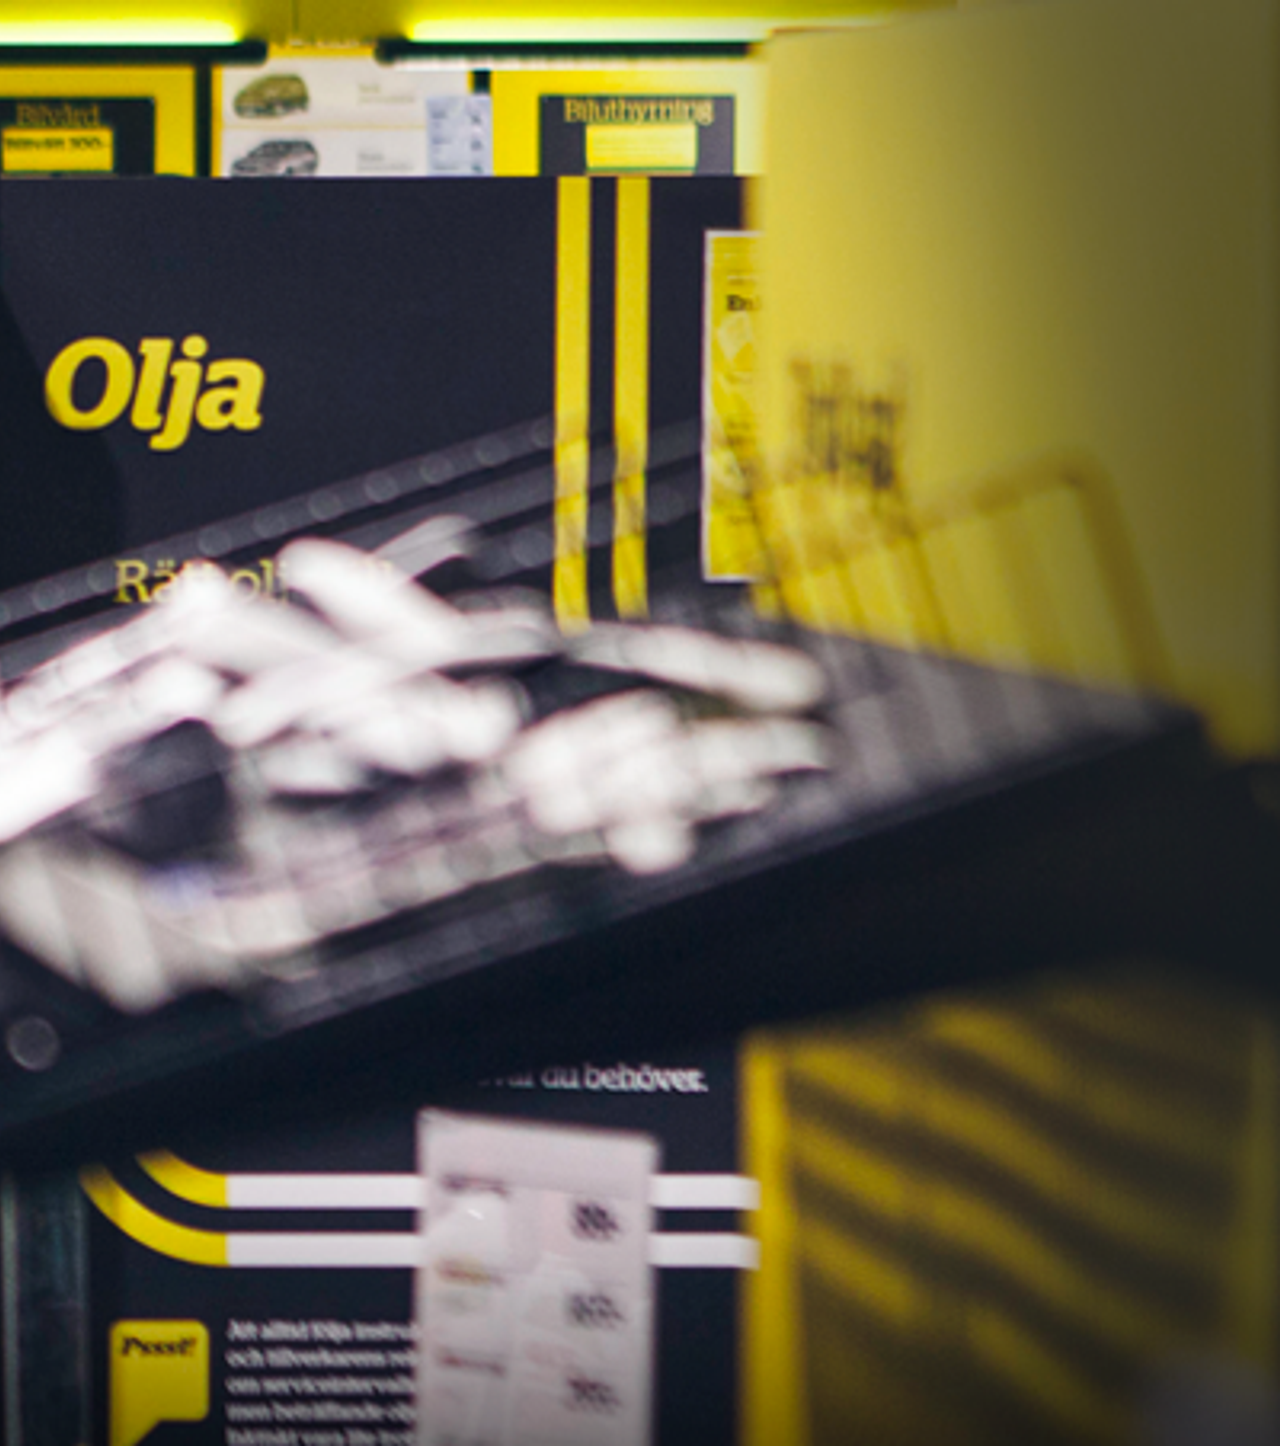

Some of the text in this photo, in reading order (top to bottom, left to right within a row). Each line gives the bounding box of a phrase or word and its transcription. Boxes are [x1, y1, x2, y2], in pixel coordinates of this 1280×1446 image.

[564, 98, 714, 126] Biluthyrning
[45, 334, 266, 450] Olja
[584, 1062, 709, 1092] behöver.
